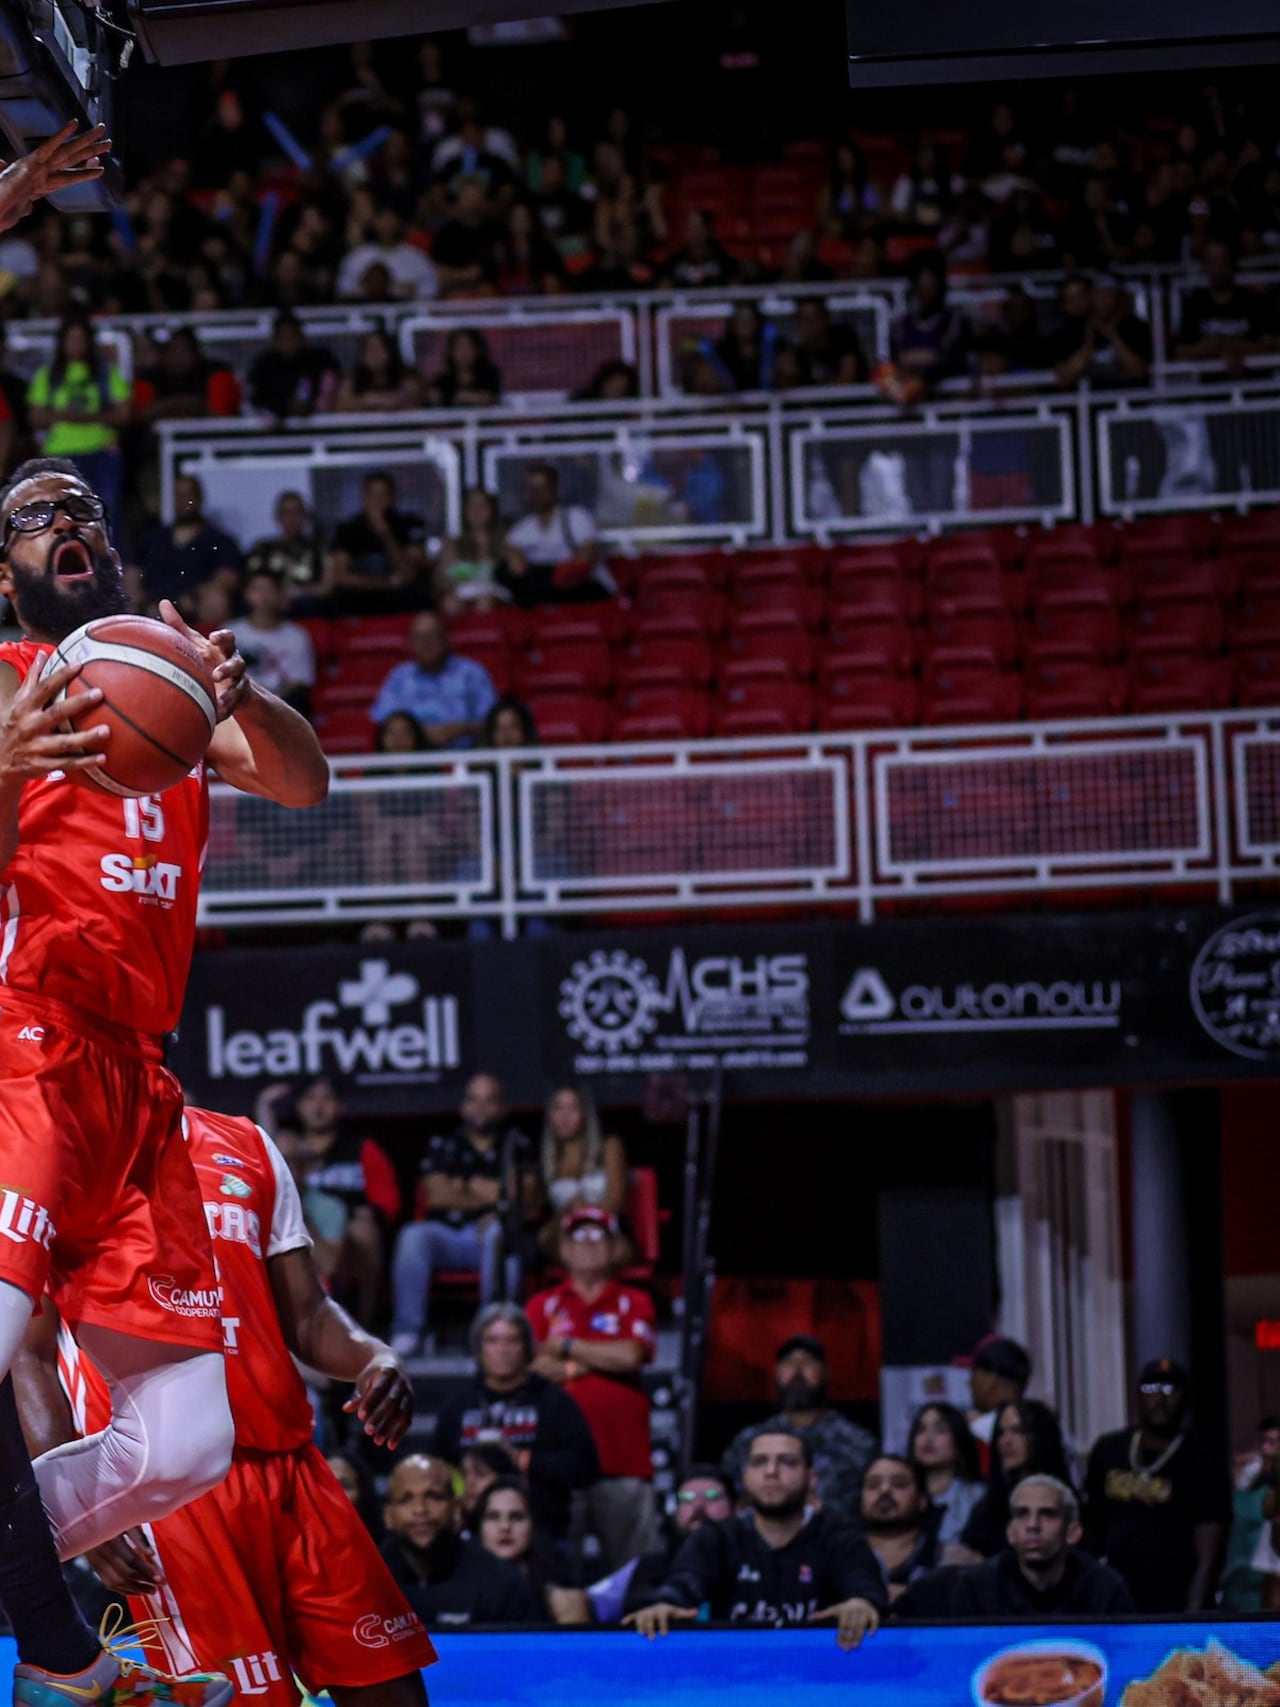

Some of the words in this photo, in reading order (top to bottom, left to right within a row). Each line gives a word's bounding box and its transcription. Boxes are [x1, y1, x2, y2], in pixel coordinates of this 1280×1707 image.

[691, 954, 809, 999] CHS
[900, 980, 1120, 1019] autonow
[17, 1026, 45, 1040] AC
[208, 997, 460, 1079] leafwell
